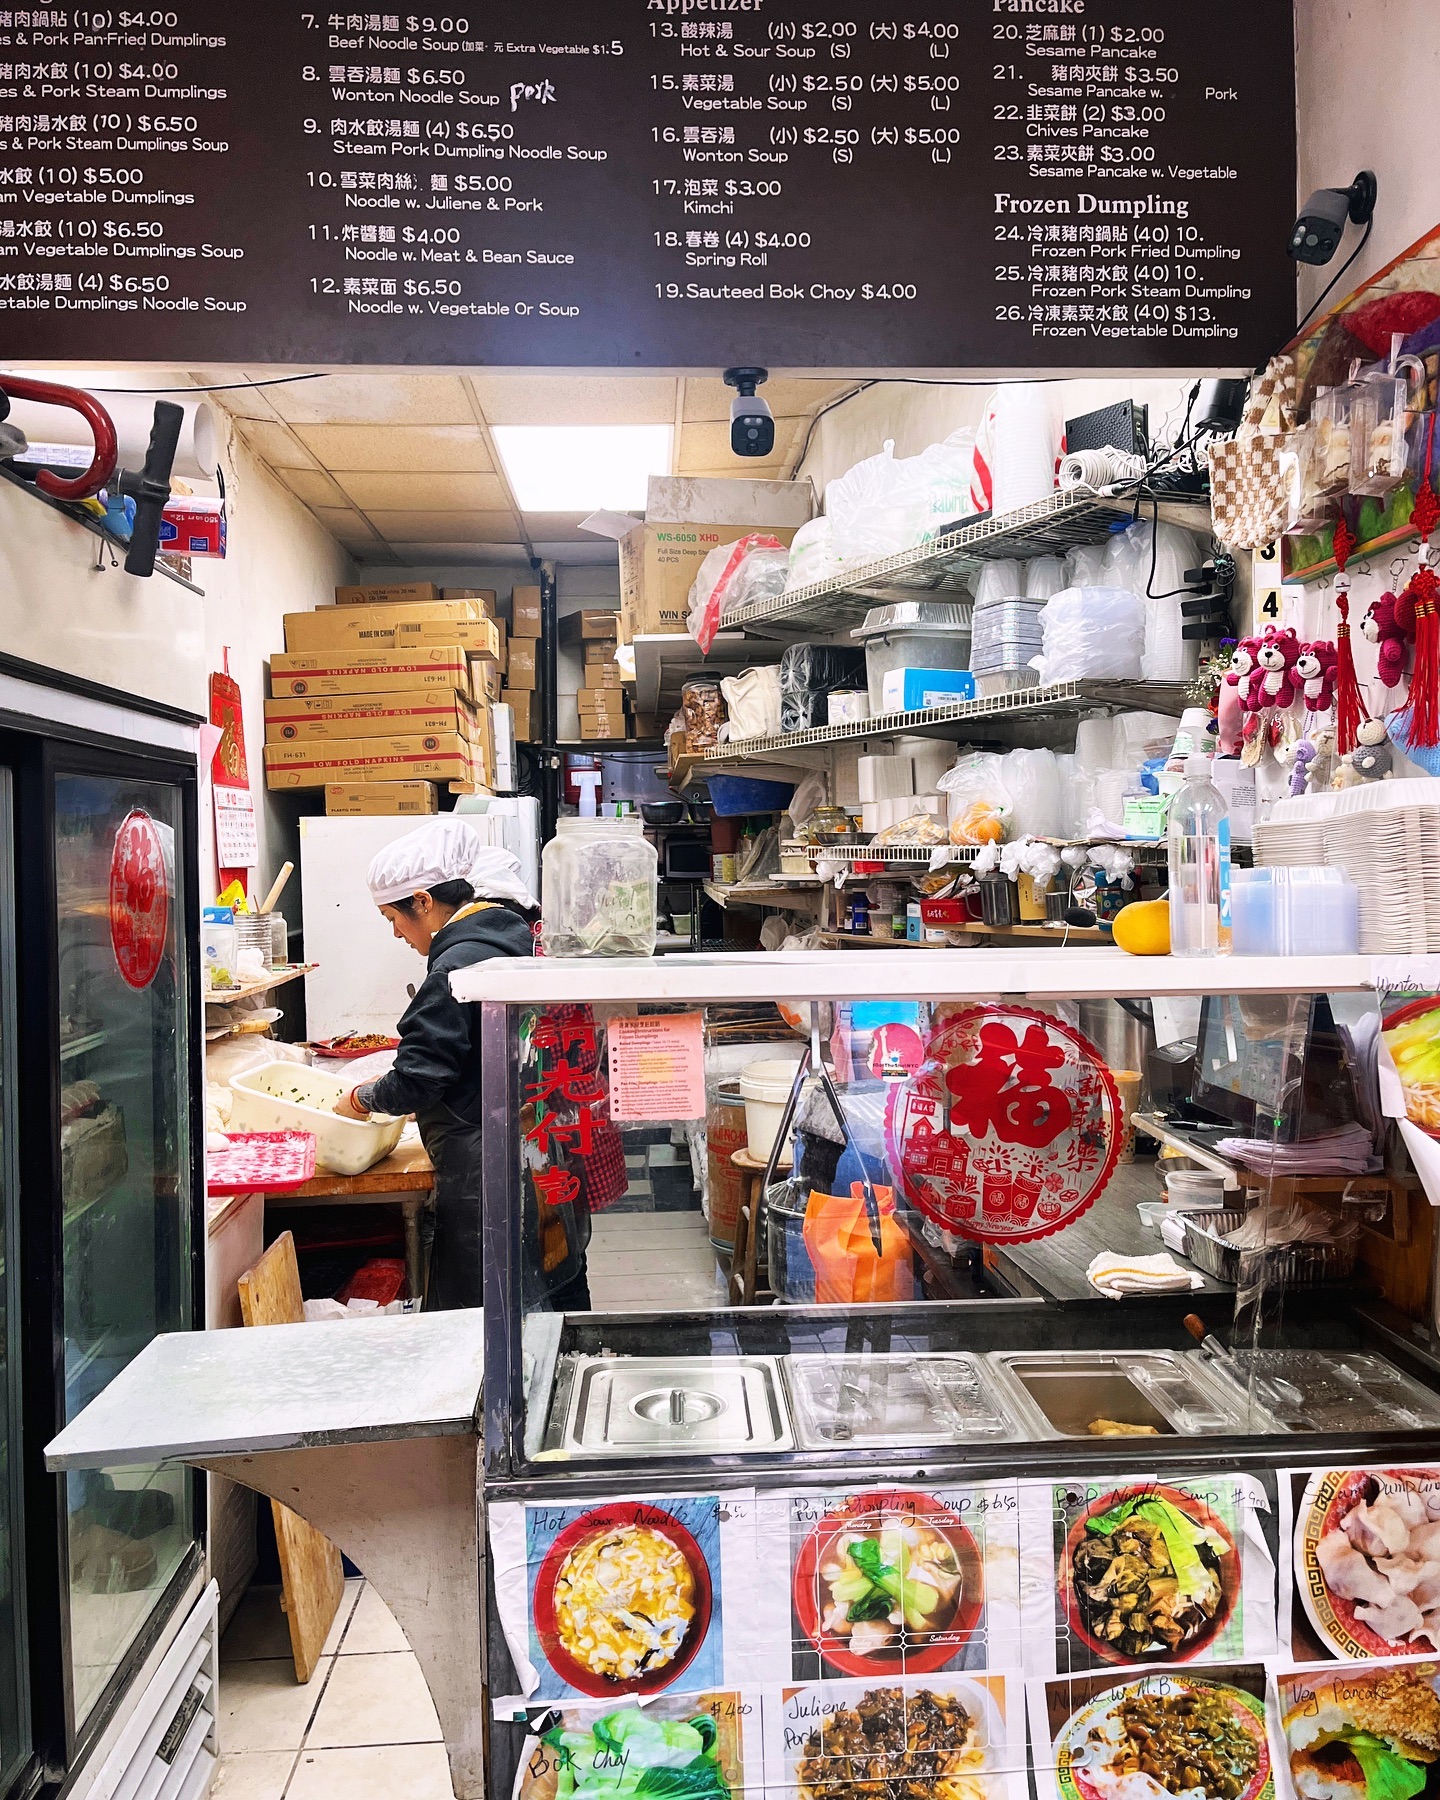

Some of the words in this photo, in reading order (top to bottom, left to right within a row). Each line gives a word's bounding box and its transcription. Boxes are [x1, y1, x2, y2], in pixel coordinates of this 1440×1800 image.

[647, 0, 763, 14] Appetizer
[993, 0, 1084, 13] Pancake
[0, 10, 67, 27] 豬肉鍋貼
[74, 10, 112, 28] (10)
[119, 11, 177, 27] $4.00
[649, 23, 678, 37] 13.
[681, 22, 733, 39] 酸辣湯
[768, 22, 795, 40] (小)
[802, 22, 856, 39] $2.00
[870, 22, 897, 40] (大)
[903, 22, 958, 39] $4.00
[16, 32, 28, 45] &
[33, 32, 69, 45] Pork
[74, 32, 146, 45] Pan-Fried
[151, 33, 226, 47] Dumplings
[329, 35, 364, 48] Beef
[369, 36, 417, 50] Noodle
[422, 38, 459, 52] Soup
[681, 43, 710, 56] Hot
[716, 44, 728, 56] &
[734, 44, 771, 57] Sour
[776, 45, 815, 59] Soup
[831, 43, 850, 58] (S)
[930, 43, 949, 58] (L)
[1026, 43, 1086, 57] Sesame
[1091, 45, 1156, 58] Pancake
[332, 87, 394, 102] Wonton
[400, 89, 453, 103] Noodle
[459, 91, 499, 106] Soup
[304, 119, 321, 133] 9.
[331, 118, 420, 137] 肉水餃湯麵
[426, 120, 450, 139] (4)
[456, 122, 513, 142] $6.50
[1026, 124, 1078, 136] Chives
[1083, 124, 1149, 137] Pancake
[334, 140, 386, 154] Steam
[392, 142, 429, 156] Pork
[435, 143, 504, 159] Dumpling
[509, 145, 562, 159] Noodle
[567, 146, 607, 161] Soup
[0, 167, 32, 184] 水餃
[39, 166, 77, 185] (10)
[84, 167, 143, 184] $5.00
[23, 189, 106, 204] Vegetable
[112, 190, 194, 205] Dumplings
[684, 200, 733, 214] Kimchi
[994, 193, 1070, 213] Frozen
[1078, 194, 1188, 219] Dumpling
[346, 247, 397, 261] Noodle
[402, 252, 416, 261] w.
[422, 248, 461, 262] Meat
[466, 249, 478, 262] &
[483, 250, 521, 263] Bean
[527, 250, 574, 264] Sauce
[686, 252, 735, 267] Spring
[741, 253, 767, 266] Roll
[1032, 244, 1085, 257] Frozen
[1091, 244, 1126, 257] Pork
[1131, 245, 1169, 257] Fried
[1175, 245, 1240, 259] Dumpling
[687, 284, 763, 298] Sauteed
[770, 284, 804, 298] Bok
[810, 284, 855, 300] Choy
[861, 283, 916, 300] $4.00
[55, 296, 138, 311] Dumplings
[143, 296, 199, 310] Noodle
[204, 297, 246, 312] Soup
[995, 306, 1024, 320] 26.
[1028, 305, 1128, 321] 冷凍素菜水餃
[1134, 304, 1169, 322] (40)
[1033, 324, 1086, 336] Frozen
[1091, 324, 1167, 337] Vegetable
[1173, 324, 1238, 338] Dumpling
[657, 533, 697, 542] WS-6050
[699, 533, 719, 542] XHD
[1262, 591, 1279, 618] 4
[659, 610, 679, 619] WIN
[359, 630, 373, 638] MADE
[374, 630, 380, 638] IN
[326, 668, 366, 676] NAPKINS
[321, 712, 360, 720] NAPKINS
[366, 710, 388, 718] FOLD
[364, 756, 404, 764] NAPKINS
[932, 1492, 972, 1530] Soup
[929, 1634, 960, 1642] Saturday
[1292, 1683, 1320, 1718] Veg
[1332, 1676, 1392, 1704] Pancake
[784, 1726, 819, 1750] Pork
